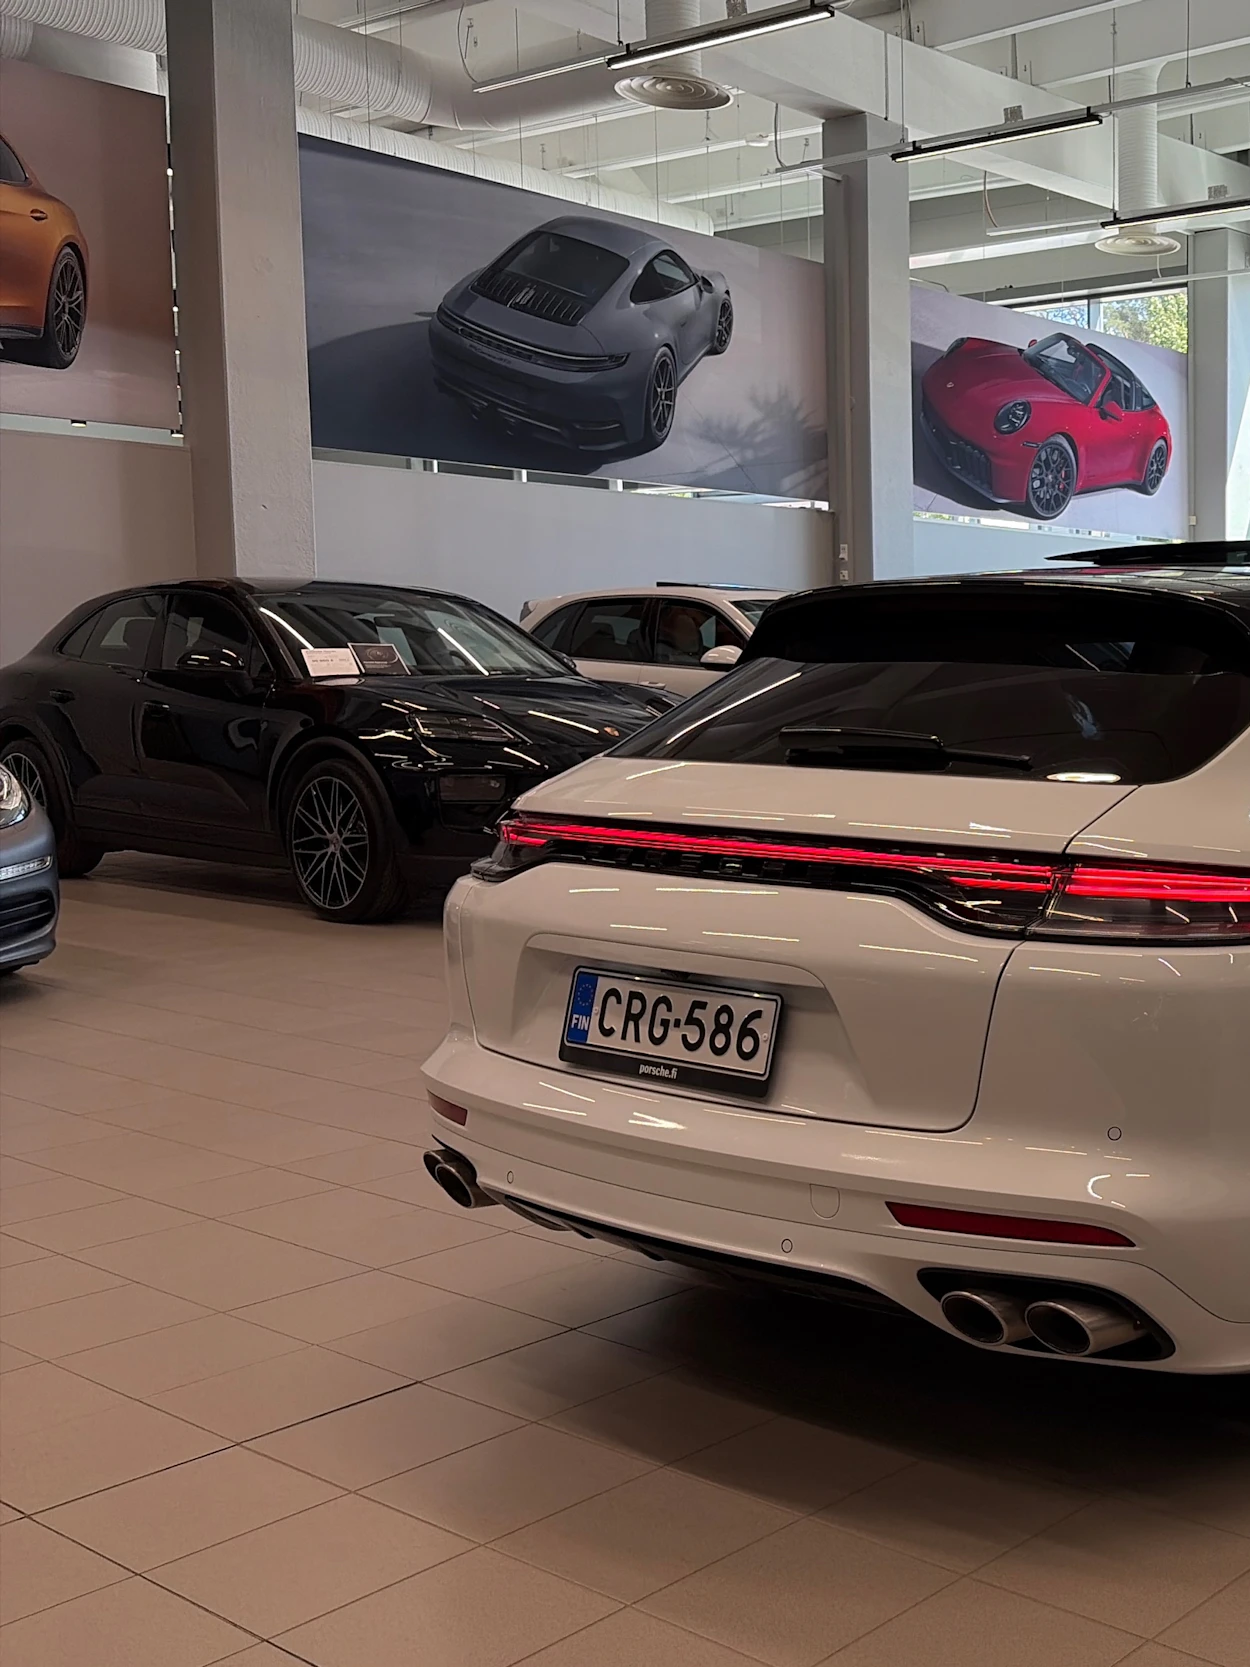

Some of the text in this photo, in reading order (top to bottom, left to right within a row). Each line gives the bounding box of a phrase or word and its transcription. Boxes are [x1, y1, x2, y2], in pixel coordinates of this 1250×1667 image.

[571, 1014, 590, 1031] FIN
[598, 987, 763, 1061] CRG-586
[639, 1063, 678, 1080] porsche.fi
